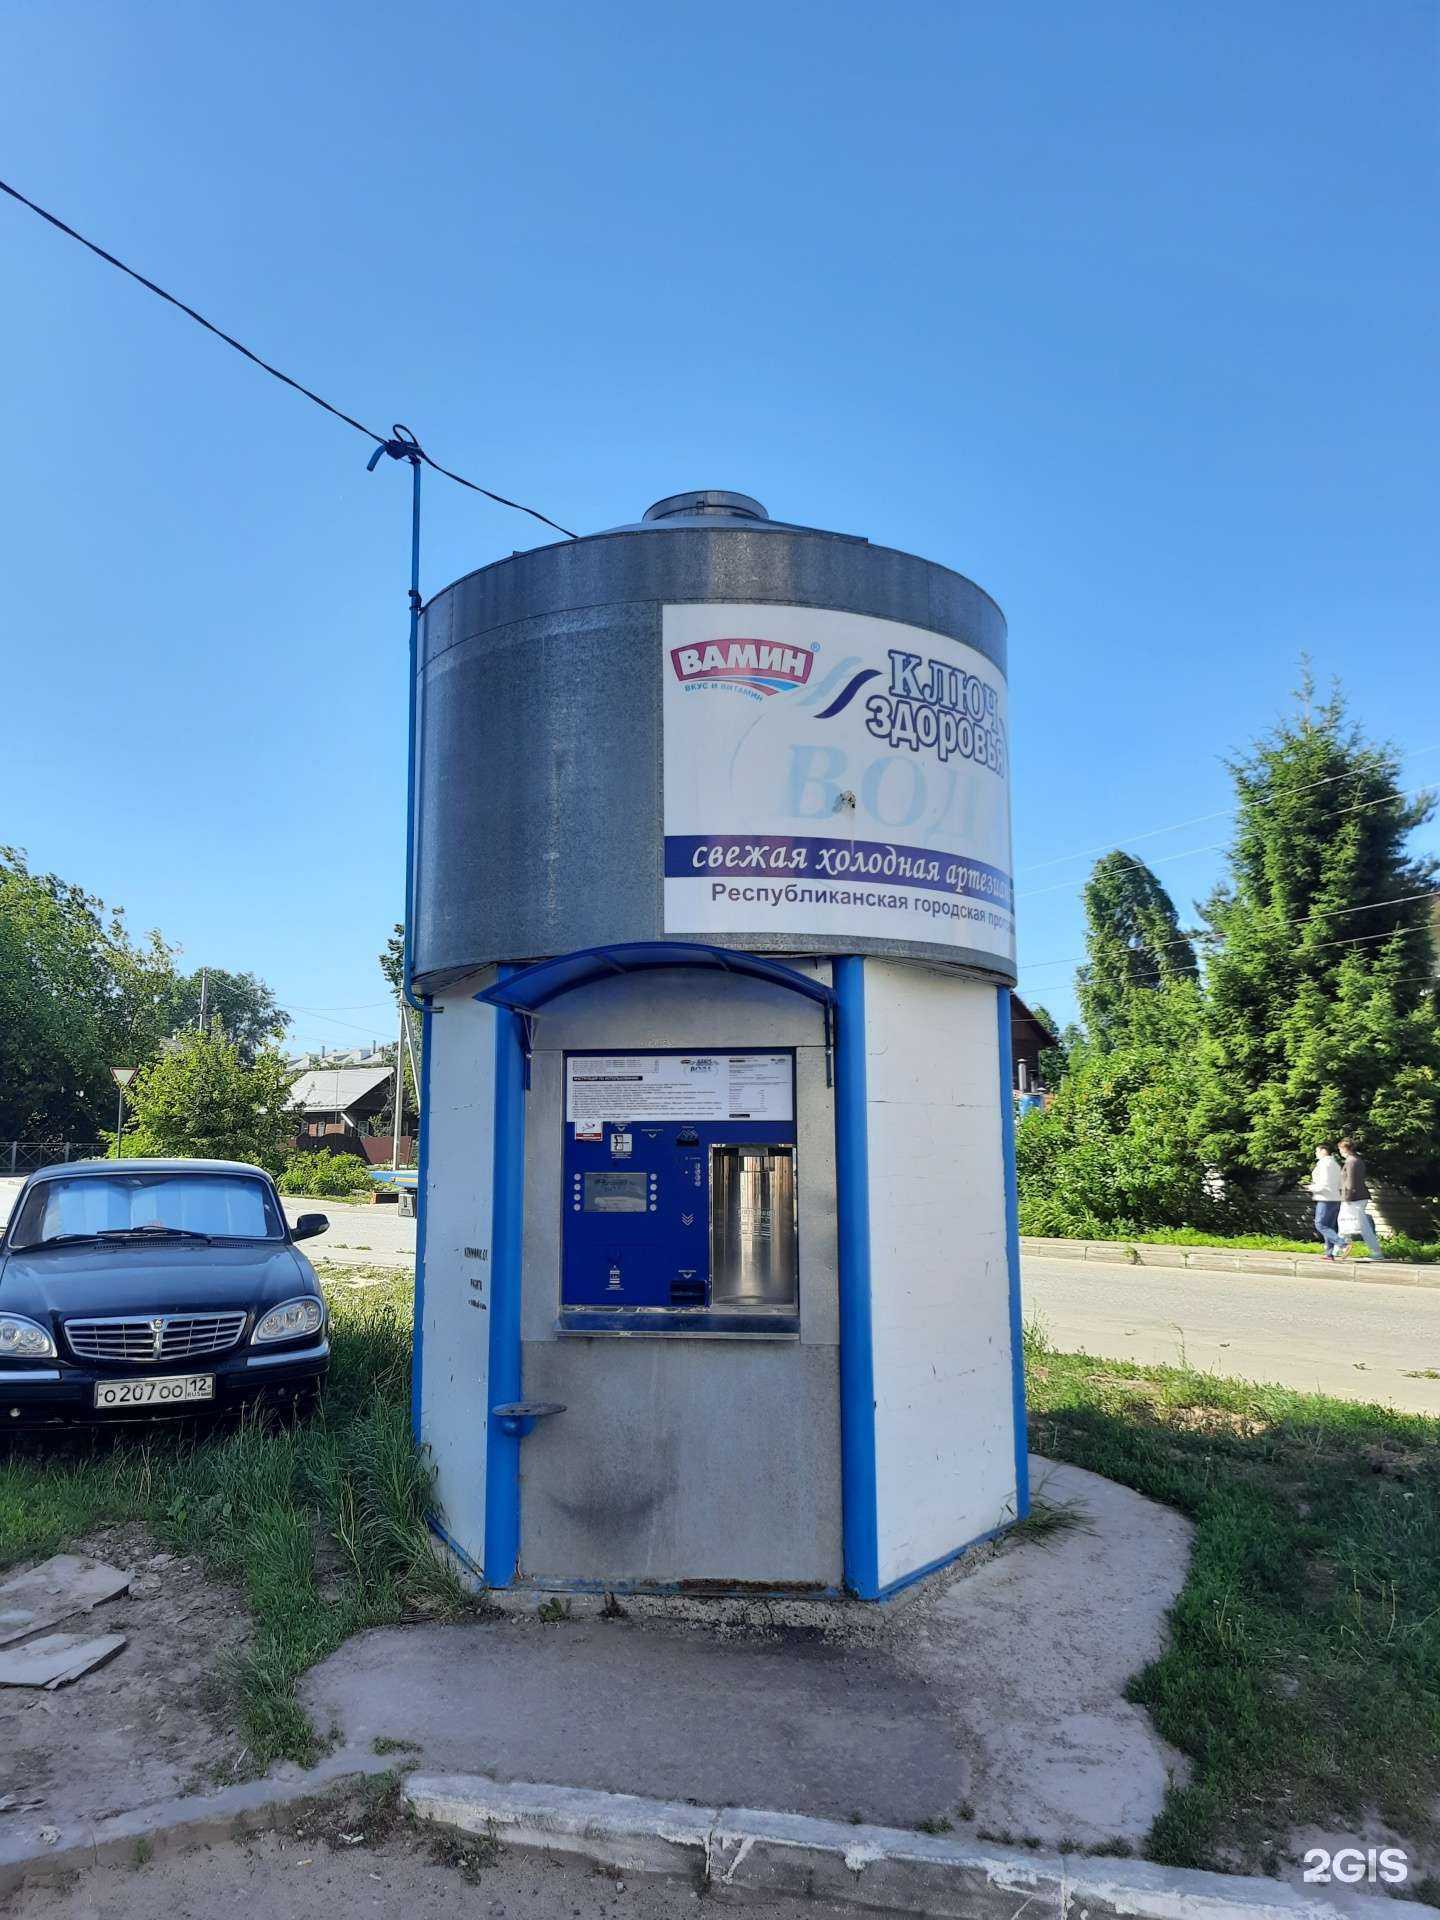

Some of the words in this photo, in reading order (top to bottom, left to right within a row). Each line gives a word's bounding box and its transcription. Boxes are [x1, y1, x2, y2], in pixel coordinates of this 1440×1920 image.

[678, 643, 806, 678] ВАМИН
[684, 681, 709, 692] ВКУС
[887, 649, 999, 734] КЛЮЧ
[692, 844, 808, 869] свежая
[815, 845, 941, 883] холодная
[711, 883, 908, 910] Республиканская
[914, 897, 986, 923] городская
[190, 1378, 207, 1391] 12
